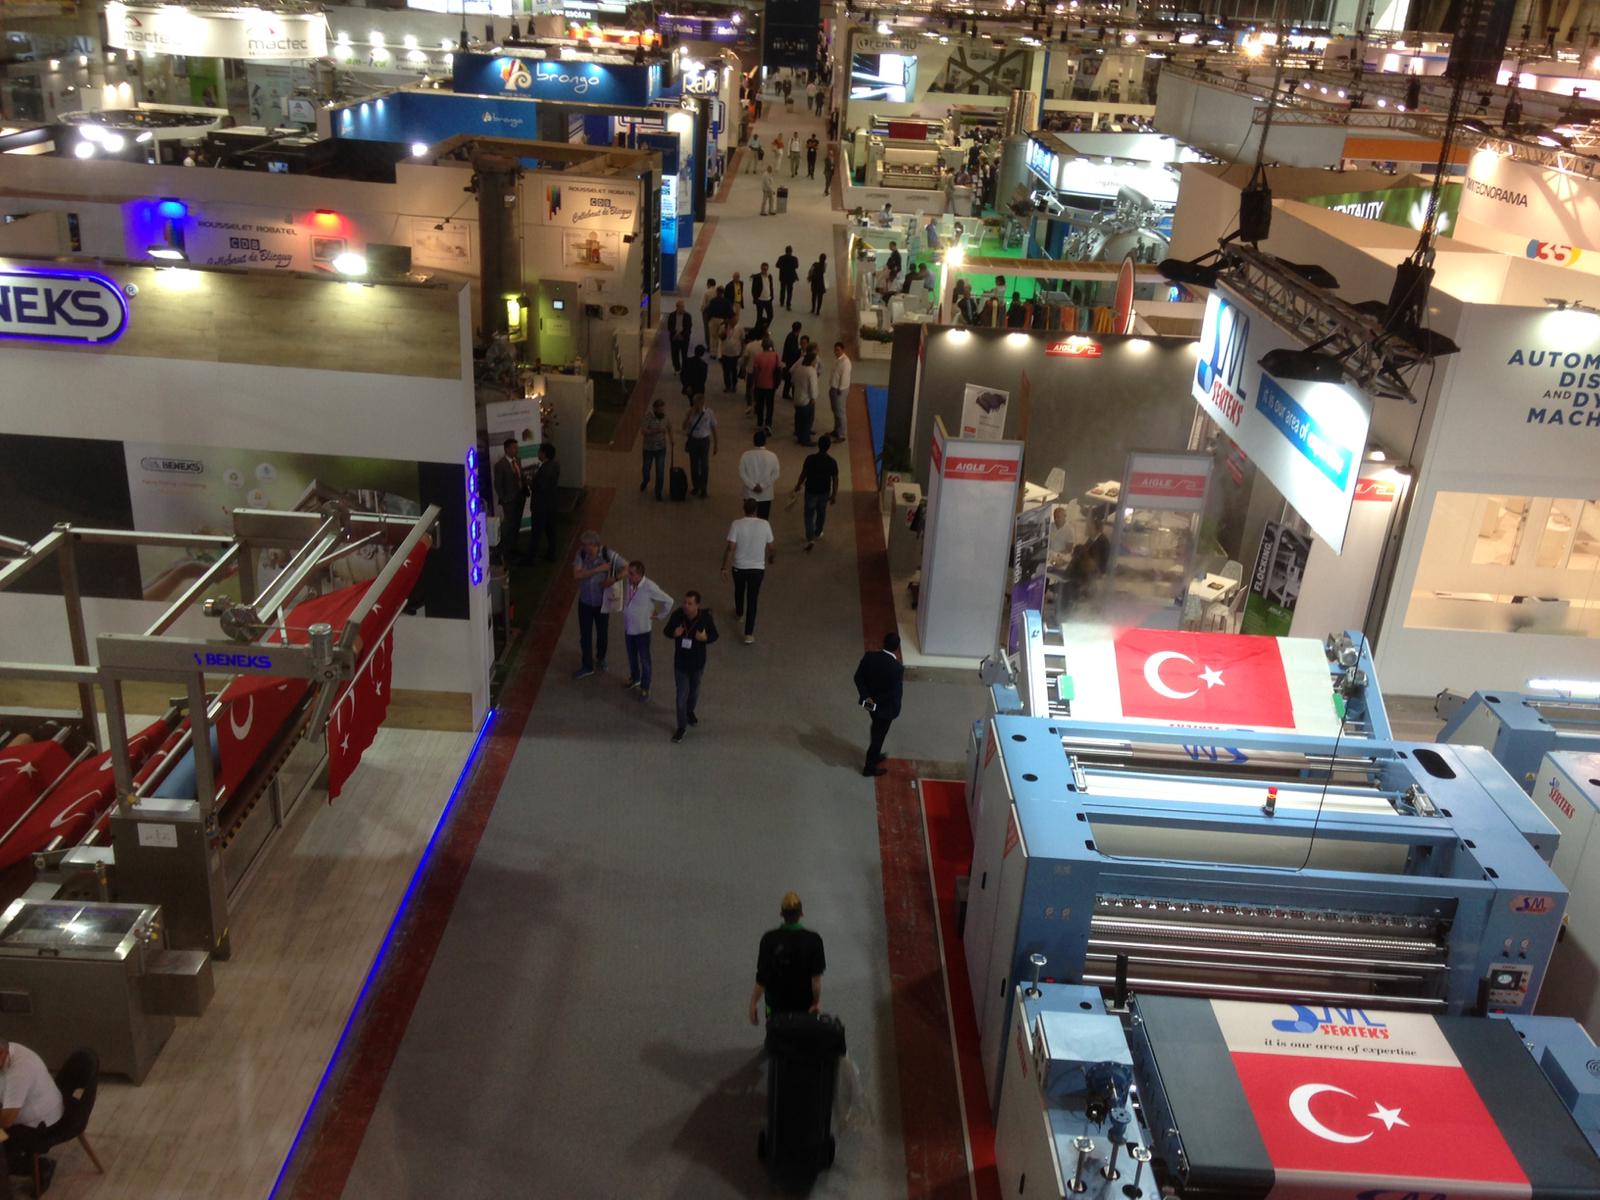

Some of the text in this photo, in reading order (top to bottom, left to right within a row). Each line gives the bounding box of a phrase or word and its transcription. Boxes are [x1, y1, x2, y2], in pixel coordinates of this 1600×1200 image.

[536, 62, 600, 94] brongo
[1507, 349, 1600, 370] AUTOM
[1559, 371, 1600, 390] DIS
[1543, 390, 1571, 400] AND
[1526, 407, 1600, 427] MACH
[955, 463, 985, 472] AIGLE
[206, 653, 272, 669] BENEKS
[1320, 1024, 1390, 1040] SERTEKS
[1265, 1038, 1273, 1047] it
[1277, 1039, 1287, 1048] is
[1315, 1043, 1344, 1051] area
[1347, 1044, 1360, 1054] of
[1362, 1047, 1417, 1057] expertise
